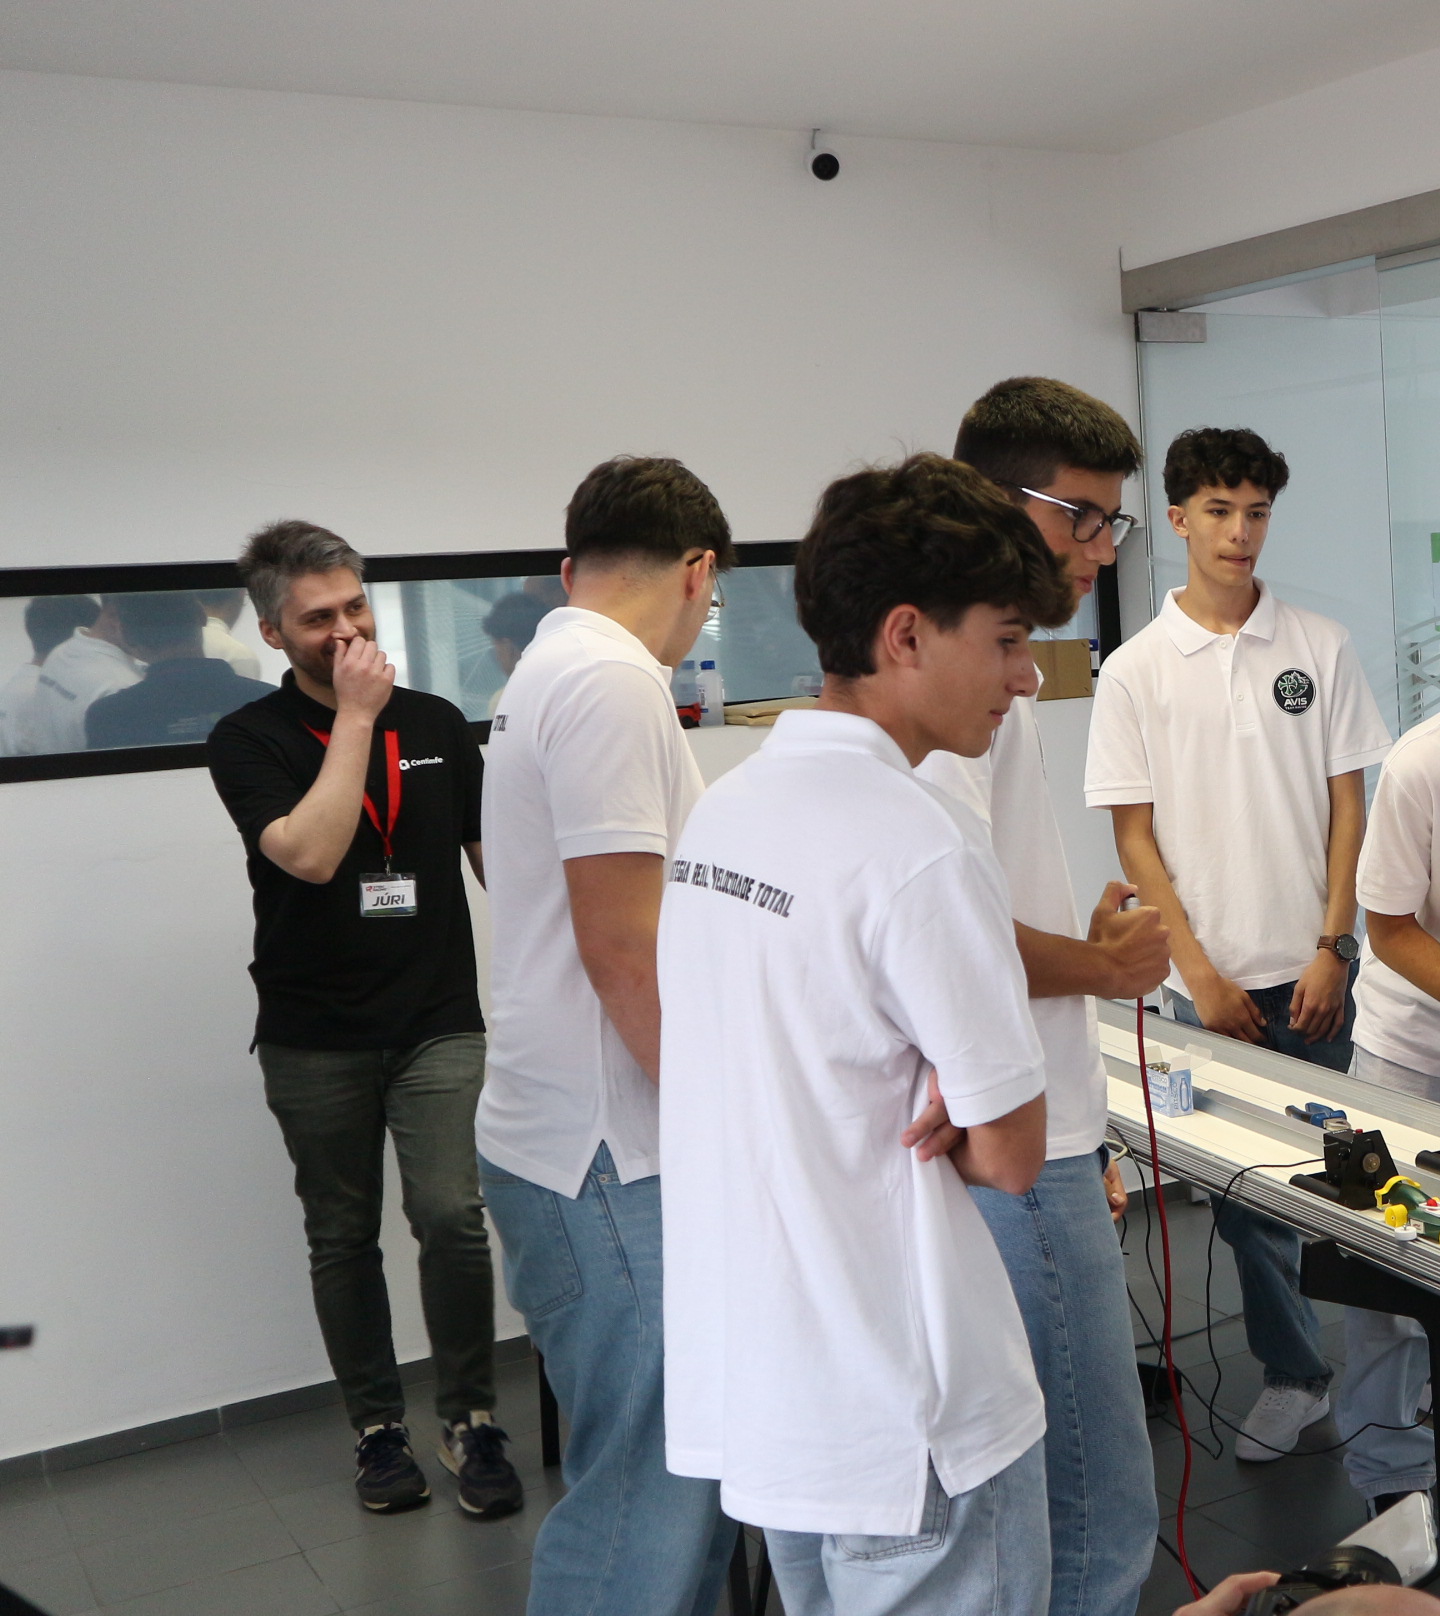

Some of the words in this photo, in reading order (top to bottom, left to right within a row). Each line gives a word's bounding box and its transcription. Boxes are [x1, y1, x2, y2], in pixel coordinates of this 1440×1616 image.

[1284, 697, 1308, 707] AVIS
[410, 756, 443, 767] Centimfe
[372, 892, 405, 907] JÚRI
[752, 881, 795, 918] TOTAL
